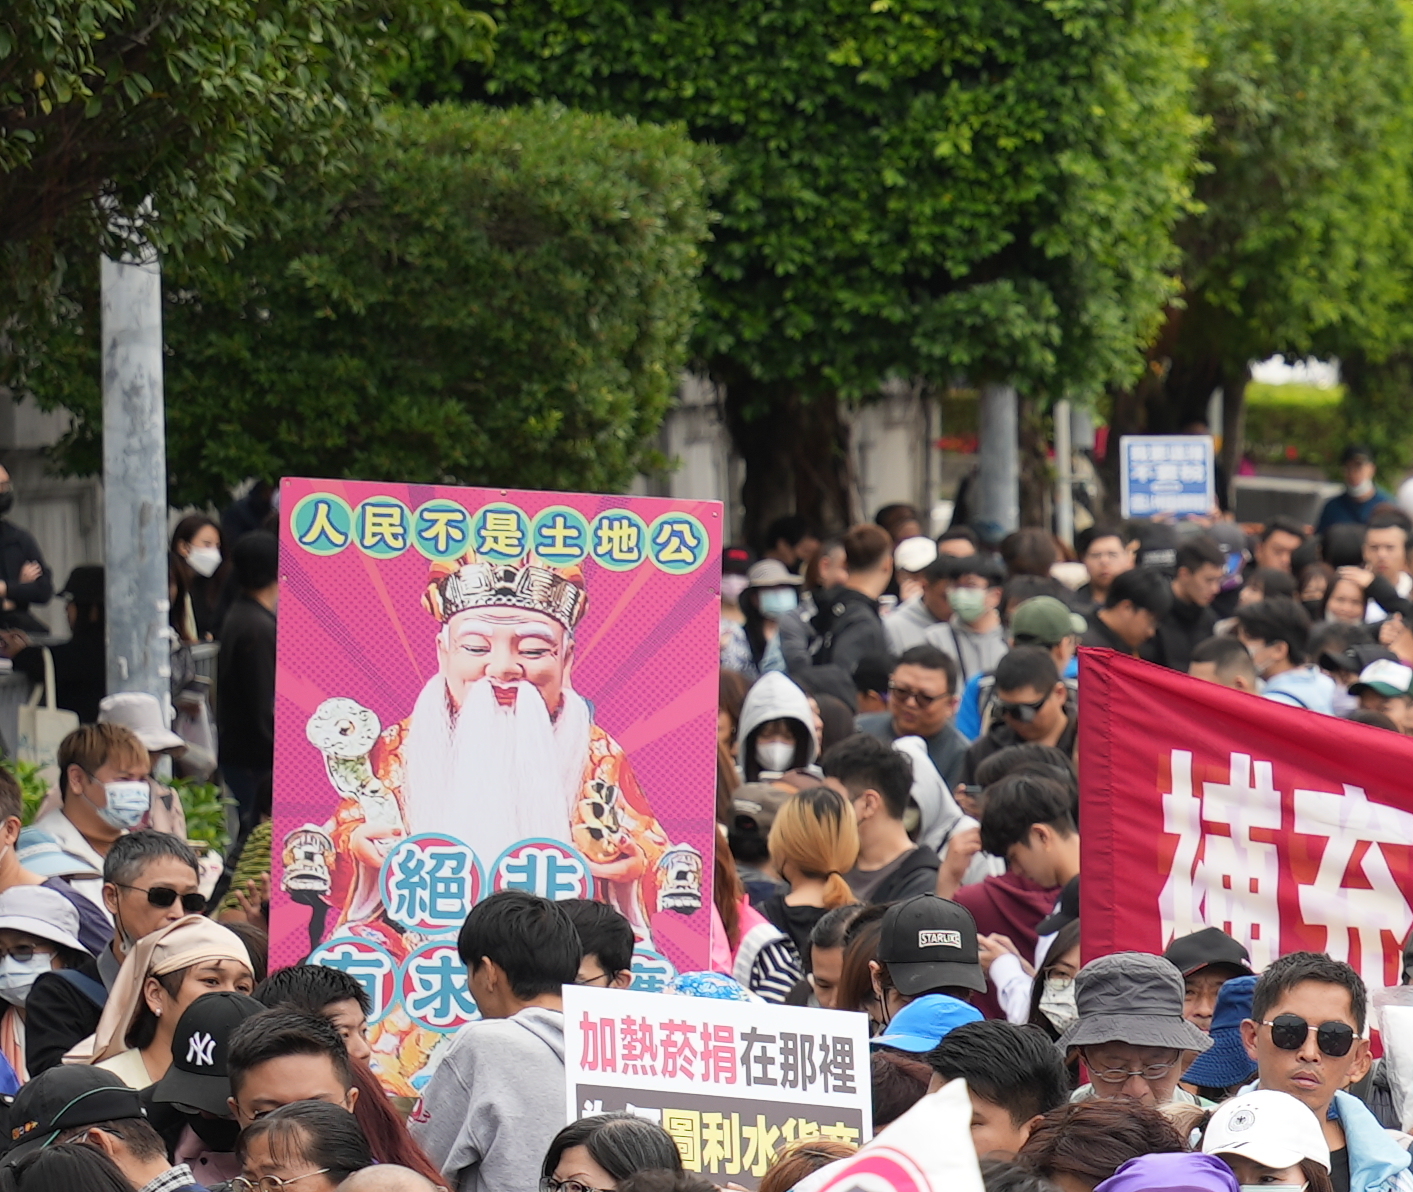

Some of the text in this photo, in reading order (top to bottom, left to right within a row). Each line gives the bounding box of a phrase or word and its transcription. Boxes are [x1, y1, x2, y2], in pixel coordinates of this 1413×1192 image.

[300, 495, 701, 567] 人民不是土地公
[391, 842, 588, 926] 絕非
[579, 1010, 857, 1095] 加熱菸捐在那裡
